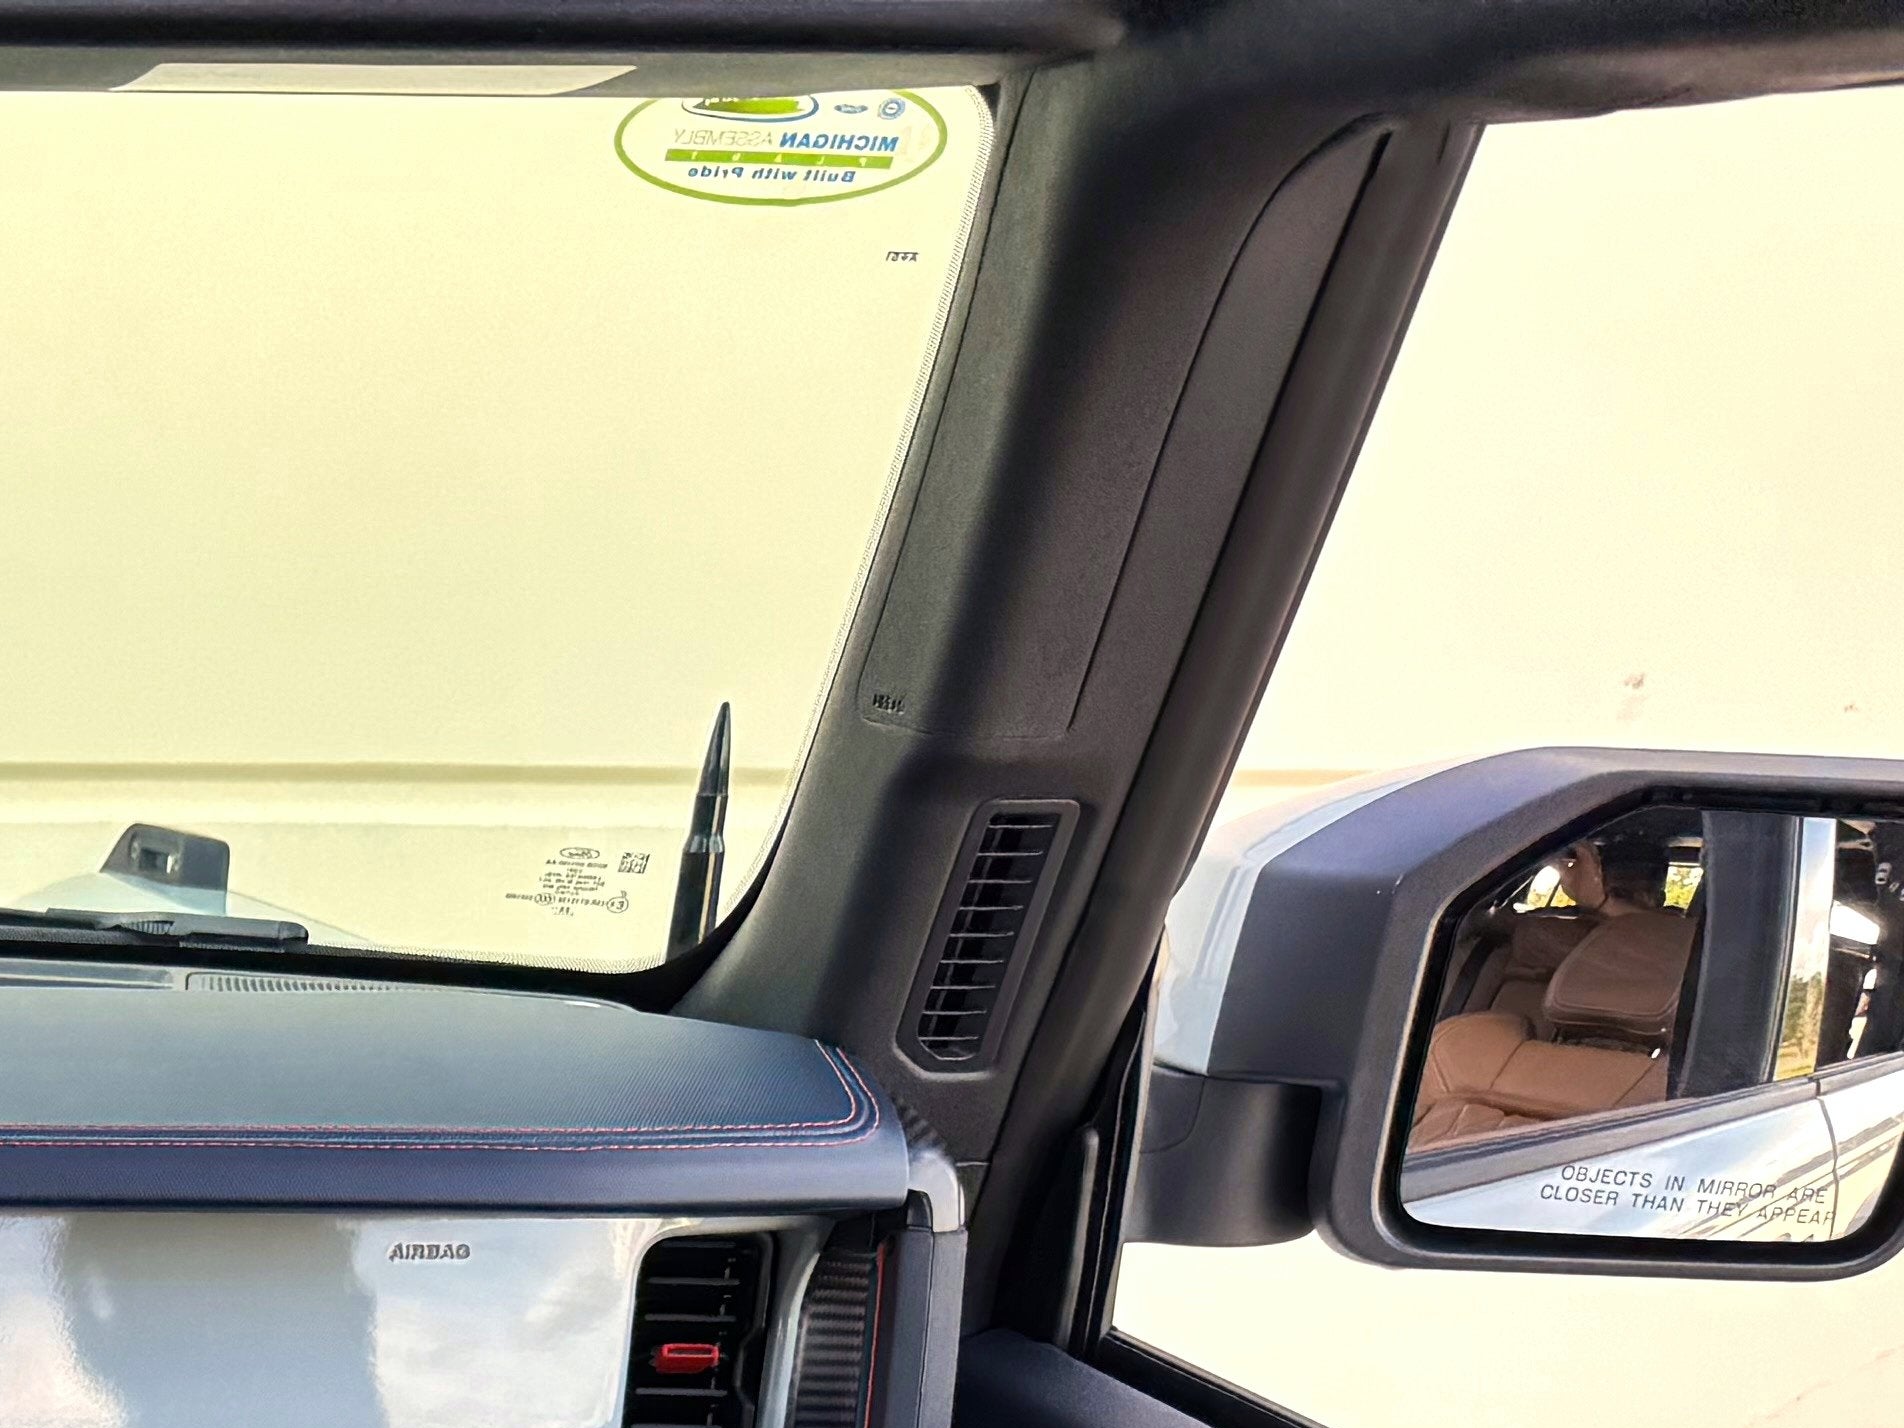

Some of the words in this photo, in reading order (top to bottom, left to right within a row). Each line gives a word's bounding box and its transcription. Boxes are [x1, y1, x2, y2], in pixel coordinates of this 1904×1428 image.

[1540, 1184, 1618, 1206] CLOSER
[1632, 1192, 1684, 1213] THAN
[1697, 1200, 1748, 1218] THEY
[1560, 1164, 1653, 1188] OBJECTS
[1664, 1175, 1686, 1192] IN
[1697, 1178, 1777, 1199] MIRROR
[1785, 1186, 1828, 1204] ARE
[388, 1242, 471, 1262] AIRBAG
